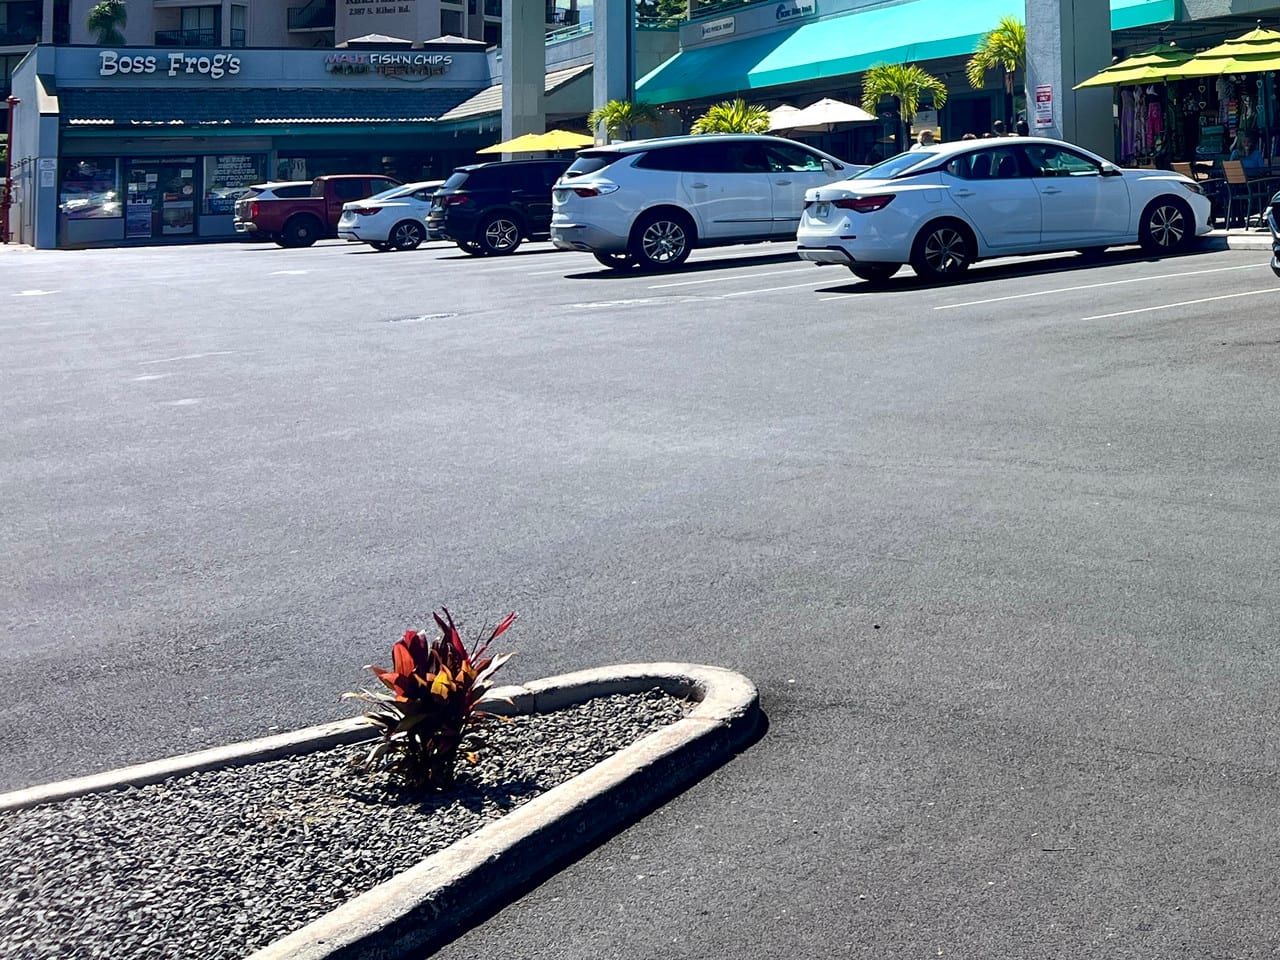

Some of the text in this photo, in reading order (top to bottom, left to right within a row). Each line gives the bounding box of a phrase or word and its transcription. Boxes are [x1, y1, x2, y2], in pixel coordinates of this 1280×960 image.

[99, 50, 241, 79] Boss Frog's
[370, 53, 410, 65] FISH'N
[414, 54, 453, 65] CHIPS
